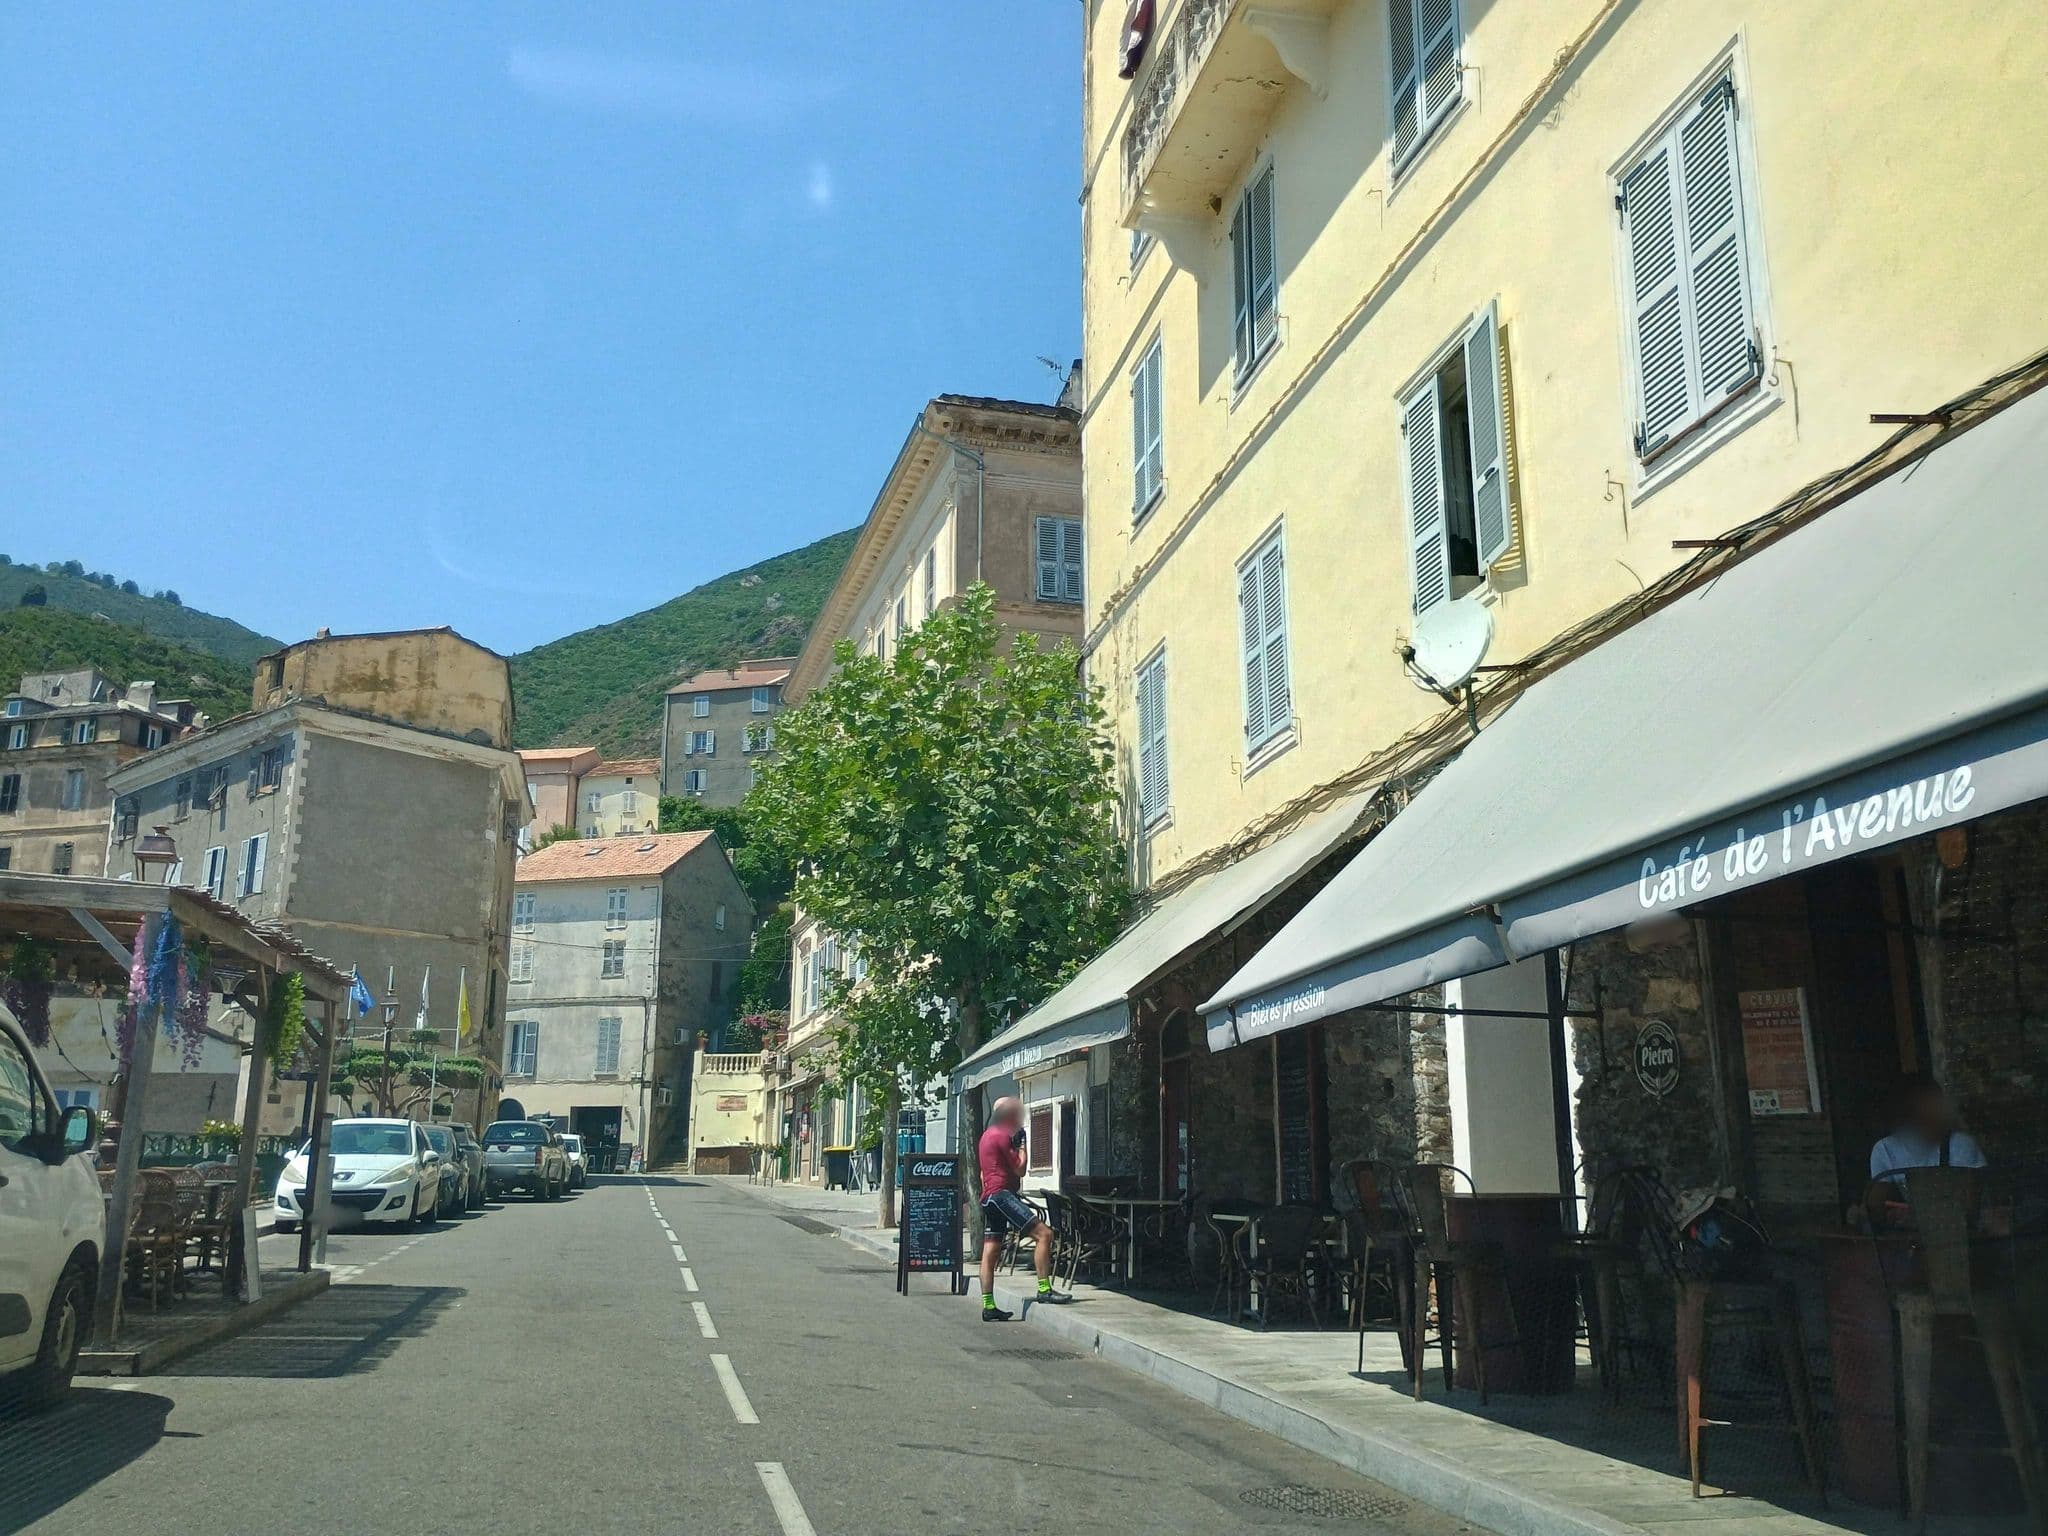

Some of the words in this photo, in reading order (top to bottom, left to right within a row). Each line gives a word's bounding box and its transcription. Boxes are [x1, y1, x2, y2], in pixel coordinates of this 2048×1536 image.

[1638, 836, 1711, 909] Café
[1723, 828, 1769, 883] de
[1783, 765, 1976, 865] l'Avenue
[1250, 999, 1281, 1028] Bières
[1282, 984, 1325, 1022] pression
[1641, 1046, 1674, 1067] Pietra
